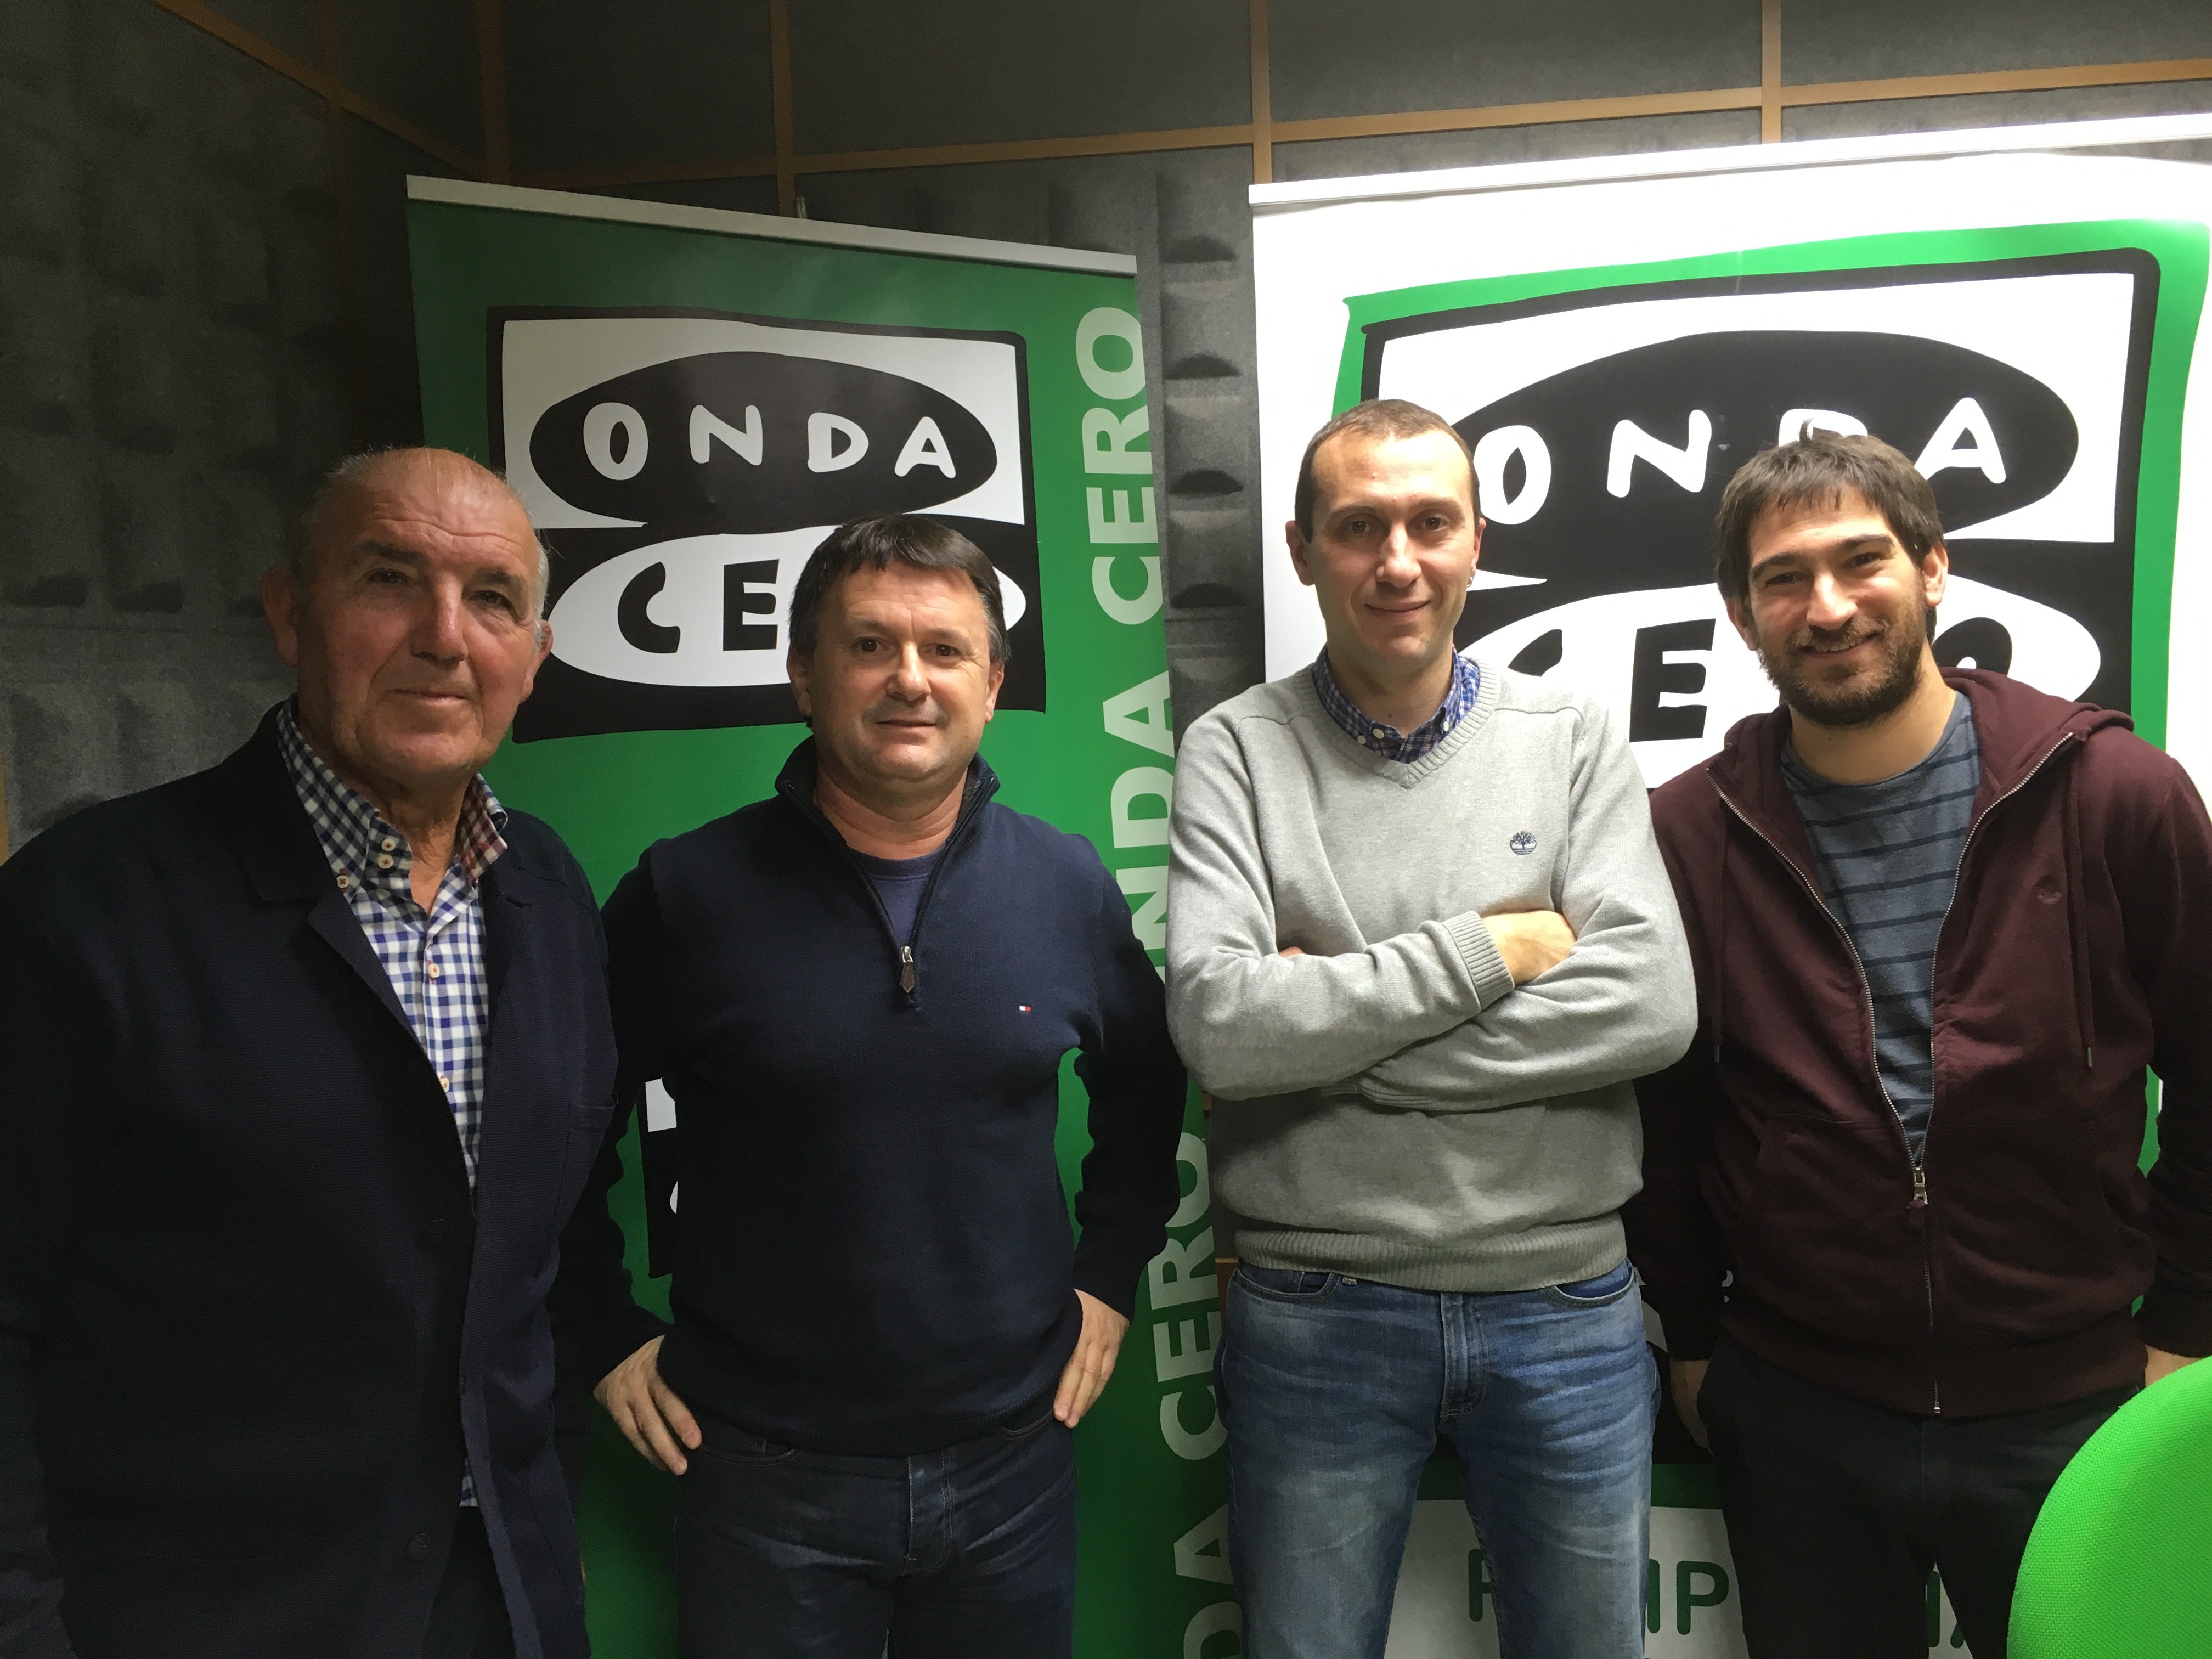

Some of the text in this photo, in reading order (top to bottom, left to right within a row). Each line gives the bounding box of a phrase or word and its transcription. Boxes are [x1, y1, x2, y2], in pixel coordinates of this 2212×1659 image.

[583, 402, 957, 481] ONDA
[617, 560, 780, 654] CE
[1075, 307, 1176, 985] NDA CERO
